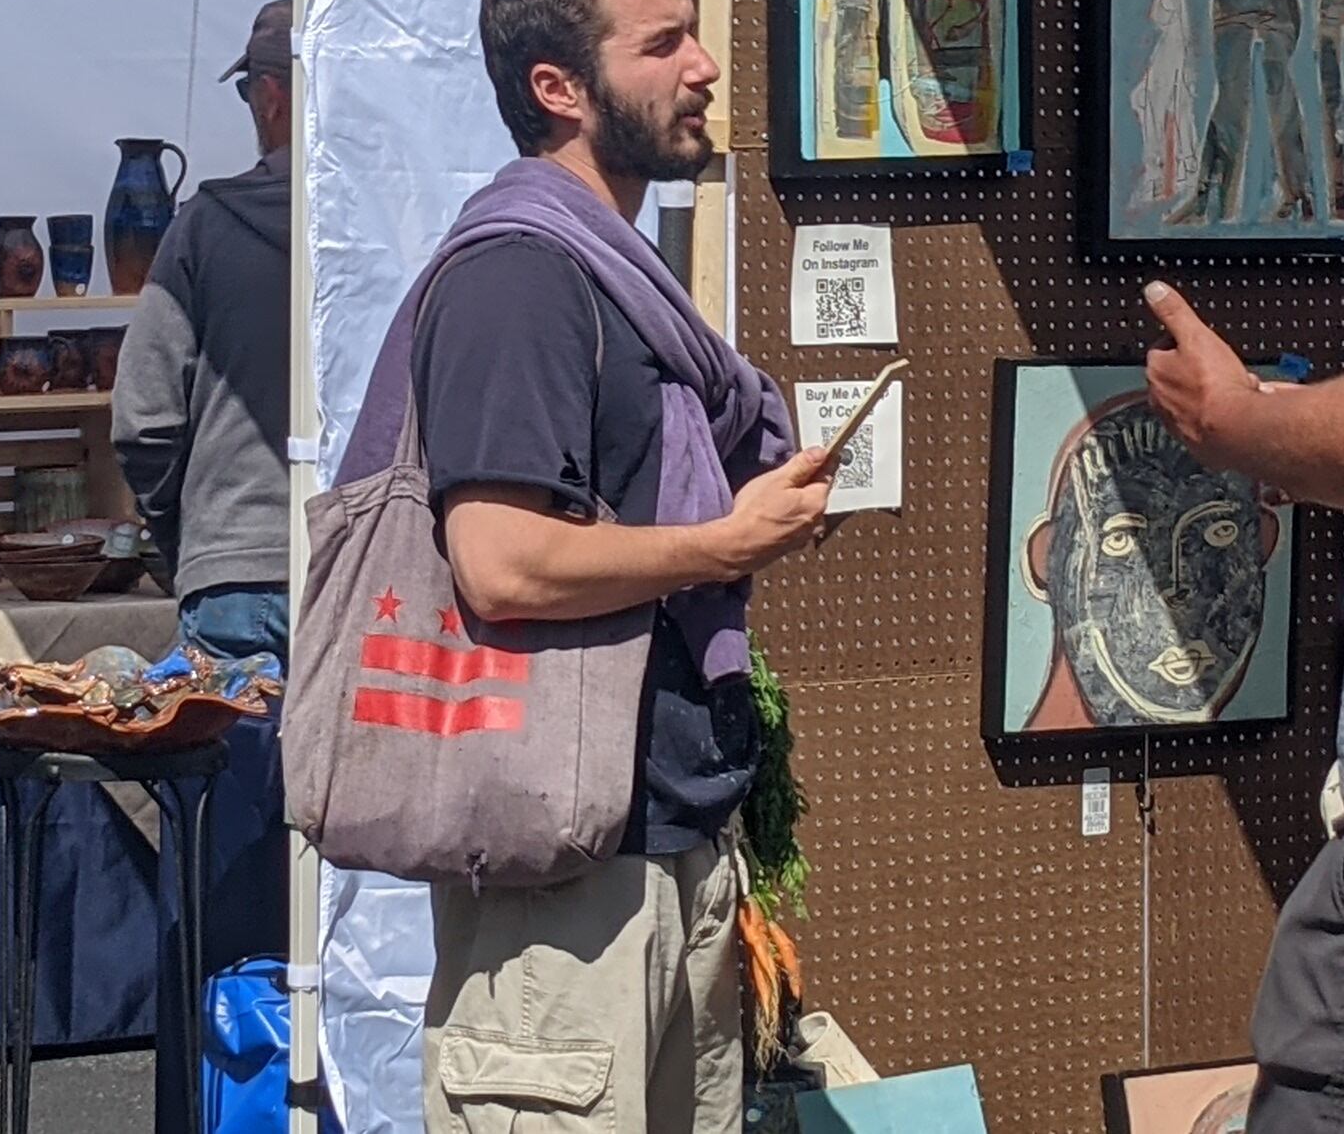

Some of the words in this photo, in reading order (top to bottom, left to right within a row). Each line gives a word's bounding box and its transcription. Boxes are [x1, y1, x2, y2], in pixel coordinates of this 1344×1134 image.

[812, 240, 851, 252] Follow
[852, 238, 869, 251] Me
[802, 259, 819, 271] On
[821, 258, 879, 272] Instagram
[805, 388, 829, 403] Buy
[832, 387, 849, 400] Me
[851, 387, 861, 399] A
[819, 405, 833, 418] Of
